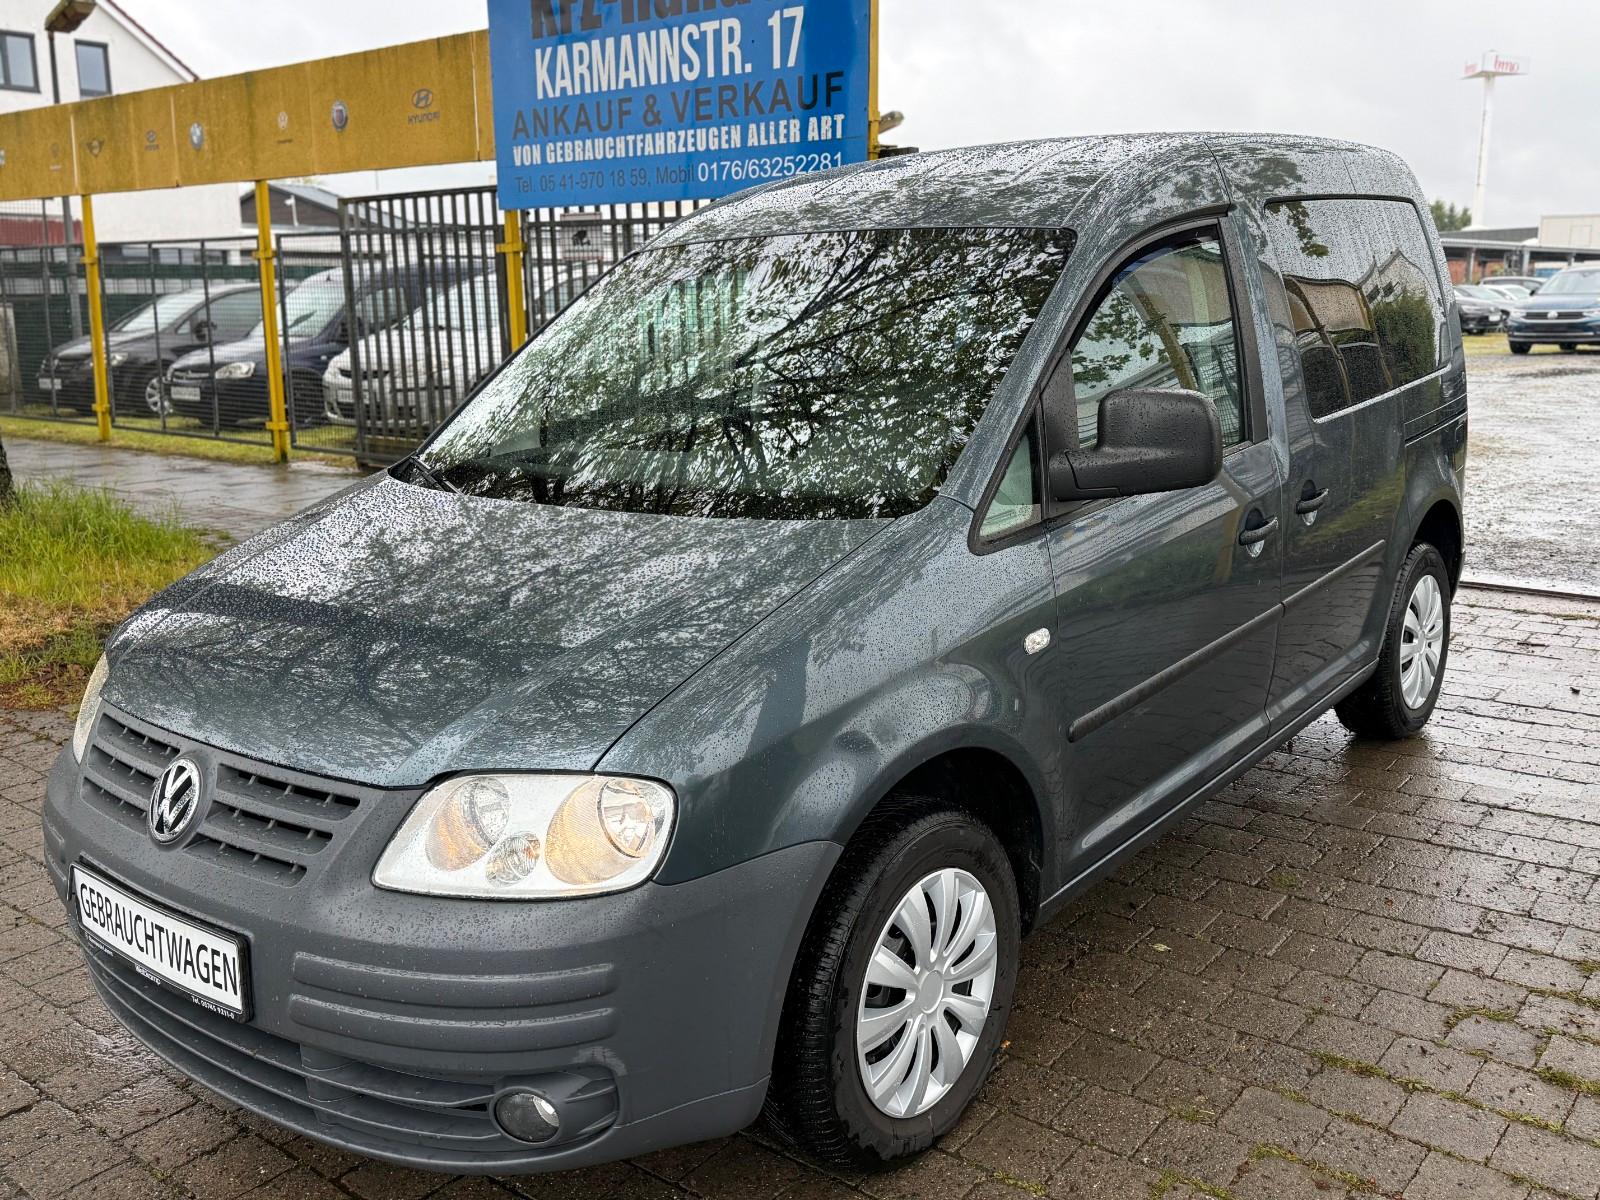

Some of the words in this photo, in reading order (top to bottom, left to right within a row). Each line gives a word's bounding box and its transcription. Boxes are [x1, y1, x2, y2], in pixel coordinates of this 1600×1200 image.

[535, 17, 753, 100] KARMANNSTR.
[767, 6, 805, 70] 17
[512, 97, 633, 140] ANKAUF
[643, 94, 662, 127] &
[670, 71, 845, 124] VERKAUF
[512, 145, 541, 166] VON
[546, 126, 741, 164] GEBRAUCHTFAHRZEUGEN
[747, 118, 801, 147] ALLER
[808, 114, 845, 142] ART
[515, 176, 536, 193] Tel.
[540, 174, 555, 192] 05
[559, 171, 604, 191] 41-970
[610, 169, 626, 188] 18
[656, 164, 694, 184] Mobil
[698, 152, 842, 182] 0176/63252281
[80, 883, 238, 996] GEBRAUCHTWAGEN
